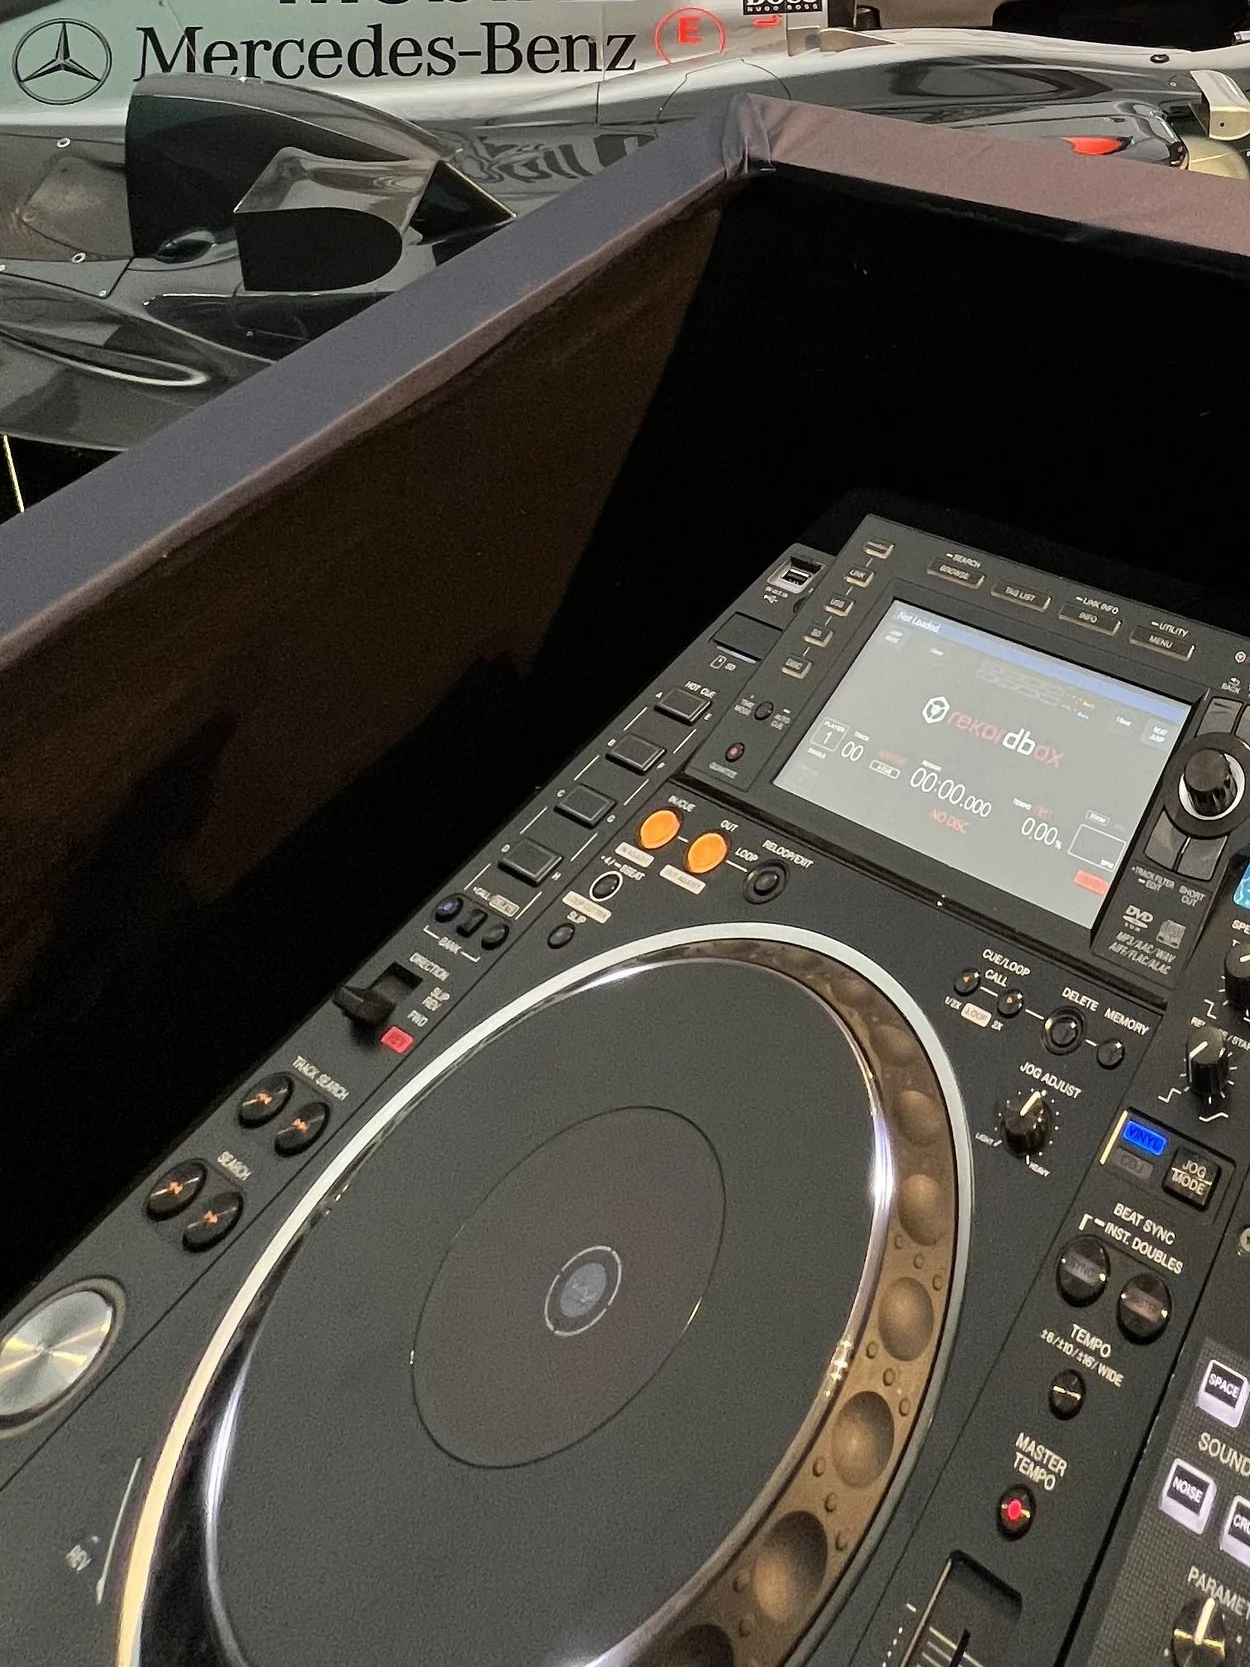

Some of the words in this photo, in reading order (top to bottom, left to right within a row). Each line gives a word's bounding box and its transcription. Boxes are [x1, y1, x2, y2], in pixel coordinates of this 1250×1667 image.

[679, 16, 702, 44] E
[134, 22, 636, 82] Mercedes-Benz
[952, 554, 981, 568] SEARCH
[1079, 612, 1098, 623] INFO
[1149, 635, 1173, 649] MENU
[1159, 623, 1190, 638] UTILITY
[701, 686, 716, 699] CUE
[822, 732, 832, 744] 1
[841, 742, 864, 762] 00
[720, 819, 739, 832] OUT
[735, 847, 758, 862] LOOP
[762, 840, 814, 868] RELOOP/EXIT
[1126, 905, 1153, 924] DVD
[982, 949, 1031, 976] CUE/LOOP
[984, 970, 1007, 987] CALL
[1062, 987, 1099, 1011] DELETE
[1104, 1008, 1148, 1035] MEMORY
[1020, 1062, 1043, 1080] JOG
[1041, 1072, 1081, 1098] ADJUST
[1129, 1126, 1160, 1150] VINYL
[217, 1150, 251, 1181] SEARCH
[1182, 1159, 1206, 1177] JOG
[1172, 1169, 1206, 1195] MODE
[1113, 1203, 1144, 1226] BEAT
[1143, 1218, 1176, 1245] SYNC
[1104, 1222, 1131, 1247] INST.
[1132, 1237, 1183, 1274] DOUBLES
[1070, 1324, 1111, 1358] TEMPO
[1098, 1363, 1124, 1387] WIDE
[1209, 1373, 1239, 1398] SPACE
[1016, 1433, 1068, 1477] MASTER
[1013, 1453, 1055, 1491] TEMPO
[1172, 1477, 1203, 1504] NOISE
